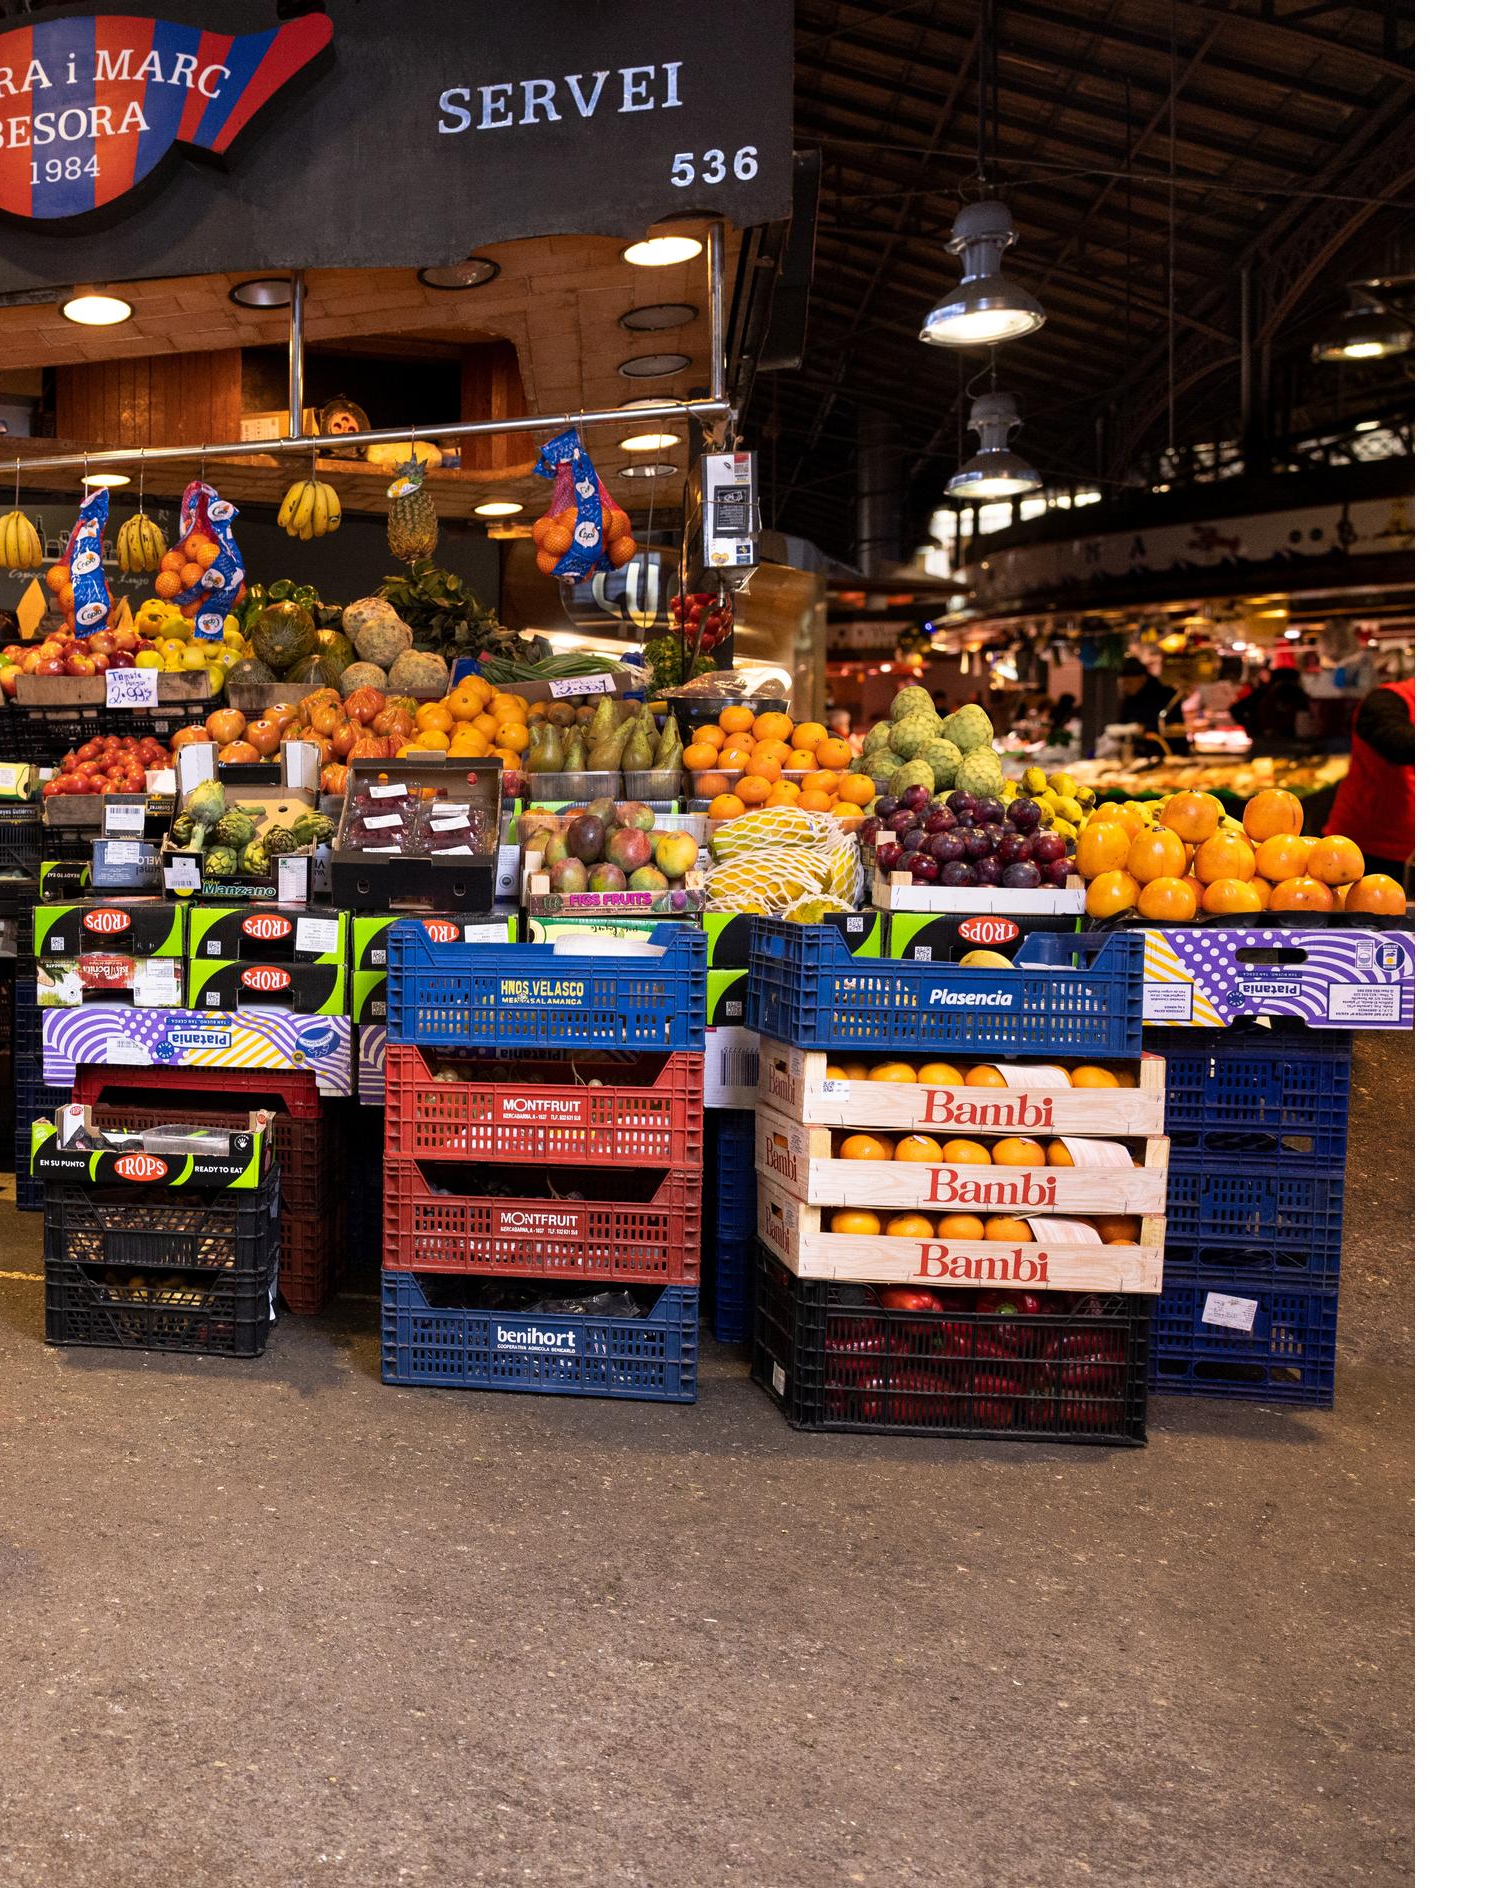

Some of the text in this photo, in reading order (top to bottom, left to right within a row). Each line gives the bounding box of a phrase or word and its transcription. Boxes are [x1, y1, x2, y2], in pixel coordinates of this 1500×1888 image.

[65, 53, 78, 84] i
[93, 48, 231, 99] MARC
[438, 61, 683, 134] SERVEI
[29, 154, 101, 184] 1984
[670, 146, 758, 188] 536
[203, 884, 276, 896] Manzano
[569, 892, 653, 907] FIGS FRUITS
[86, 913, 129, 931] TROPS
[244, 919, 289, 938] TROPS
[427, 925, 458, 942] TRO
[961, 923, 1015, 942] TROPS
[244, 971, 289, 989] TROPS
[1243, 984, 1297, 994] Platania
[930, 989, 1013, 1006] Plasencia
[172, 1034, 227, 1046] Platania
[768, 1064, 795, 1106] Bambi
[503, 1098, 581, 1112] MONTFRUIT
[918, 1089, 1055, 1127] Bambi
[39, 1159, 85, 1168] EN SU PUNTO
[115, 1153, 165, 1176] TROPS
[765, 1136, 797, 1182] Bambi
[194, 1165, 243, 1174] READY TO EAT
[923, 1168, 1059, 1206] Bambi
[501, 1212, 578, 1227] MONTFRUIT
[766, 1207, 790, 1255] Bambi
[913, 1243, 1050, 1282] Bambi
[497, 1326, 576, 1347] benihort
